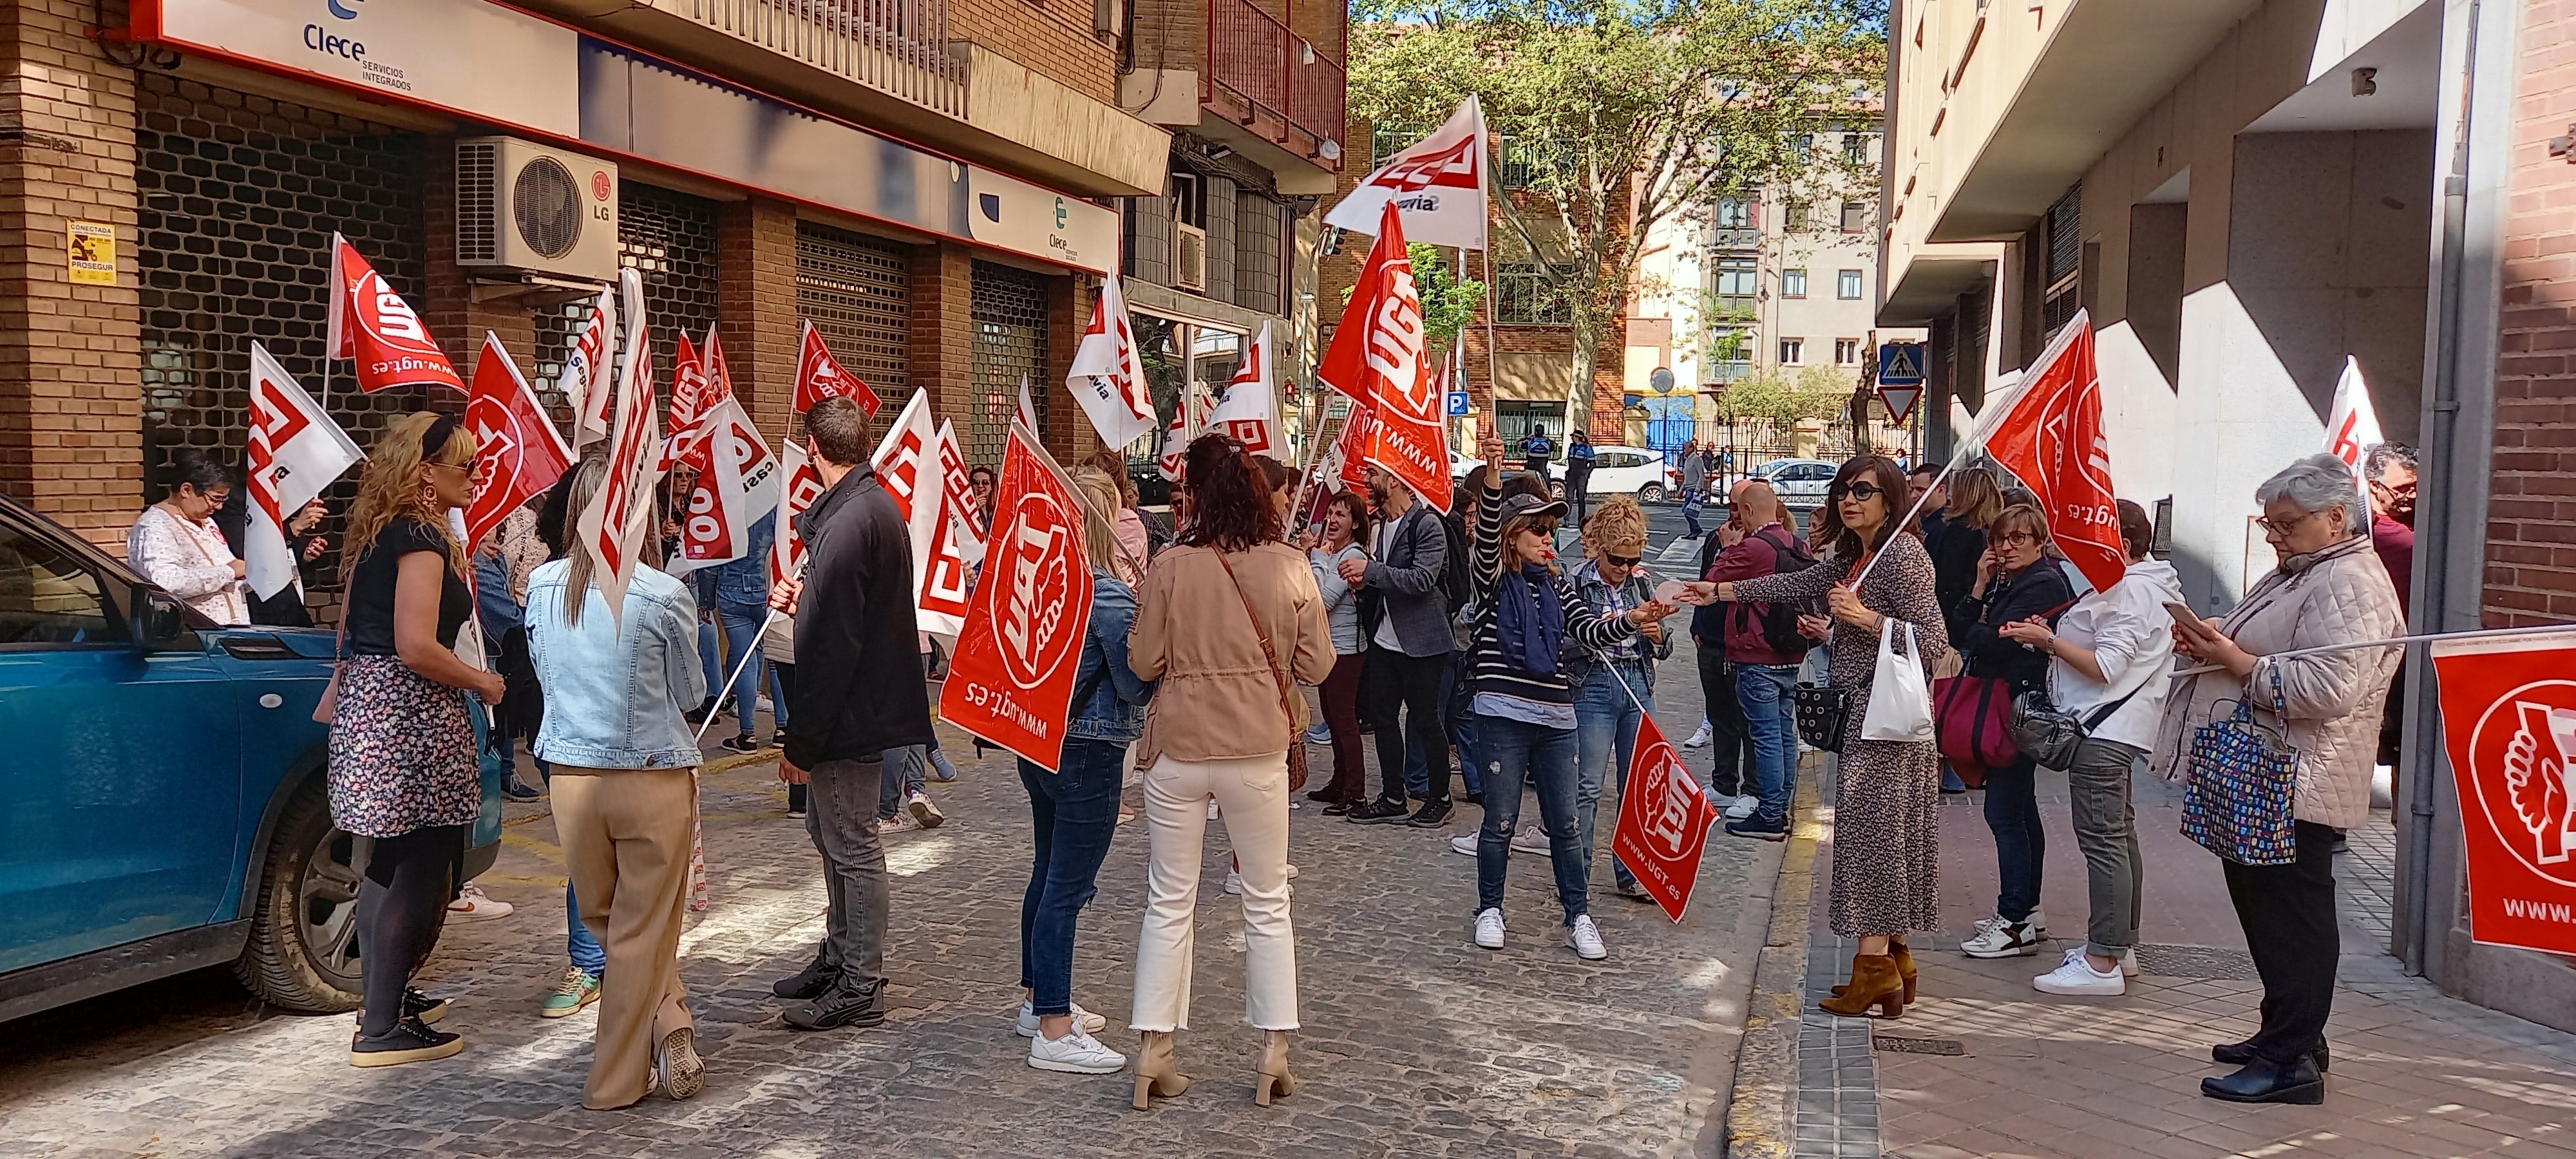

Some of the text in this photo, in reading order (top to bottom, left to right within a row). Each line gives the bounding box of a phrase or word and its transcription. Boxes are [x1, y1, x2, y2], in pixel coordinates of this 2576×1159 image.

[303, 24, 365, 61] Clece
[362, 61, 404, 79] SERVICIOS
[362, 71, 412, 91] INTEGRADOS
[594, 205, 609, 221] LG
[70, 224, 111, 233] CONECTADA
[1049, 233, 1067, 250] Clece
[71, 261, 113, 270] PROSEGUR
[670, 366, 708, 425] UGT
[1450, 395, 1463, 412] P
[1005, 512, 1052, 659] UGT
[965, 682, 1047, 740] www.ugt.es
[1658, 762, 1700, 853] UGT
[1622, 832, 1681, 901] www.UGT.es
